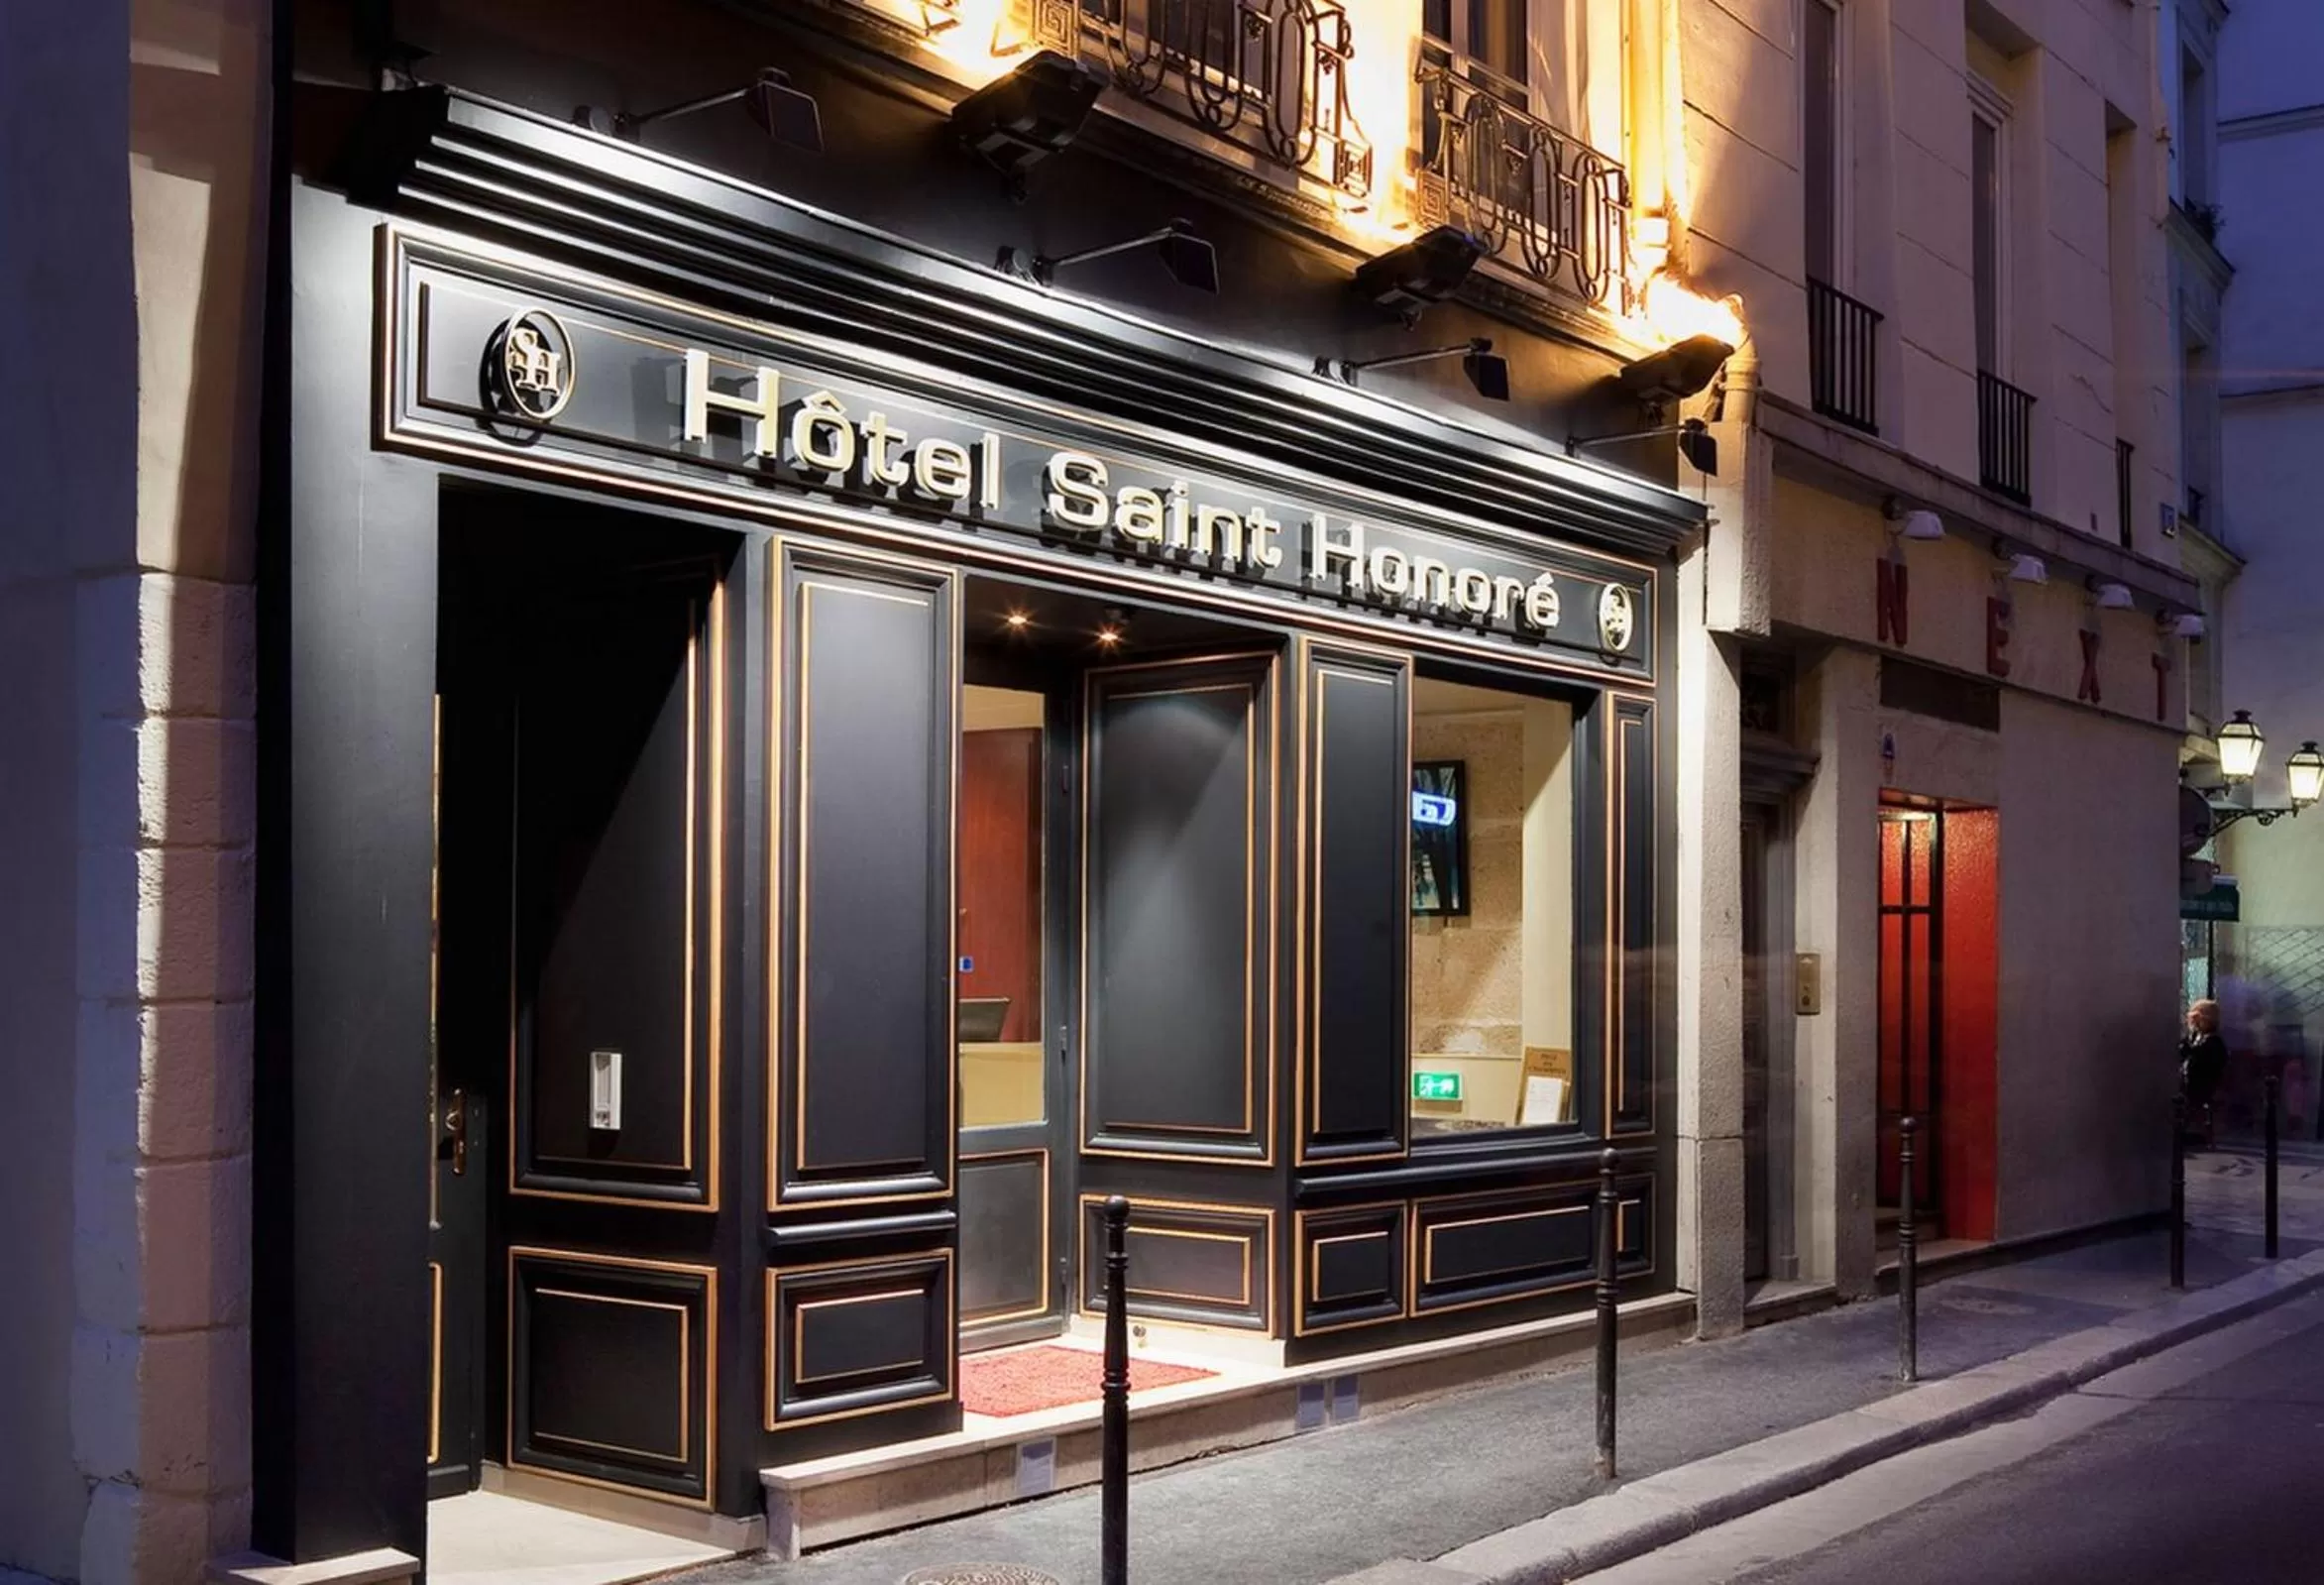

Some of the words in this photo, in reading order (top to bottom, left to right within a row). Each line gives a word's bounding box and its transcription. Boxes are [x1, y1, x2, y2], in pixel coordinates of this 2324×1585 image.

[683, 348, 1001, 510] Hôtel
[1046, 450, 1282, 570] Saint
[1309, 511, 1561, 629] Honoré
[1876, 557, 2170, 722] NEXT
